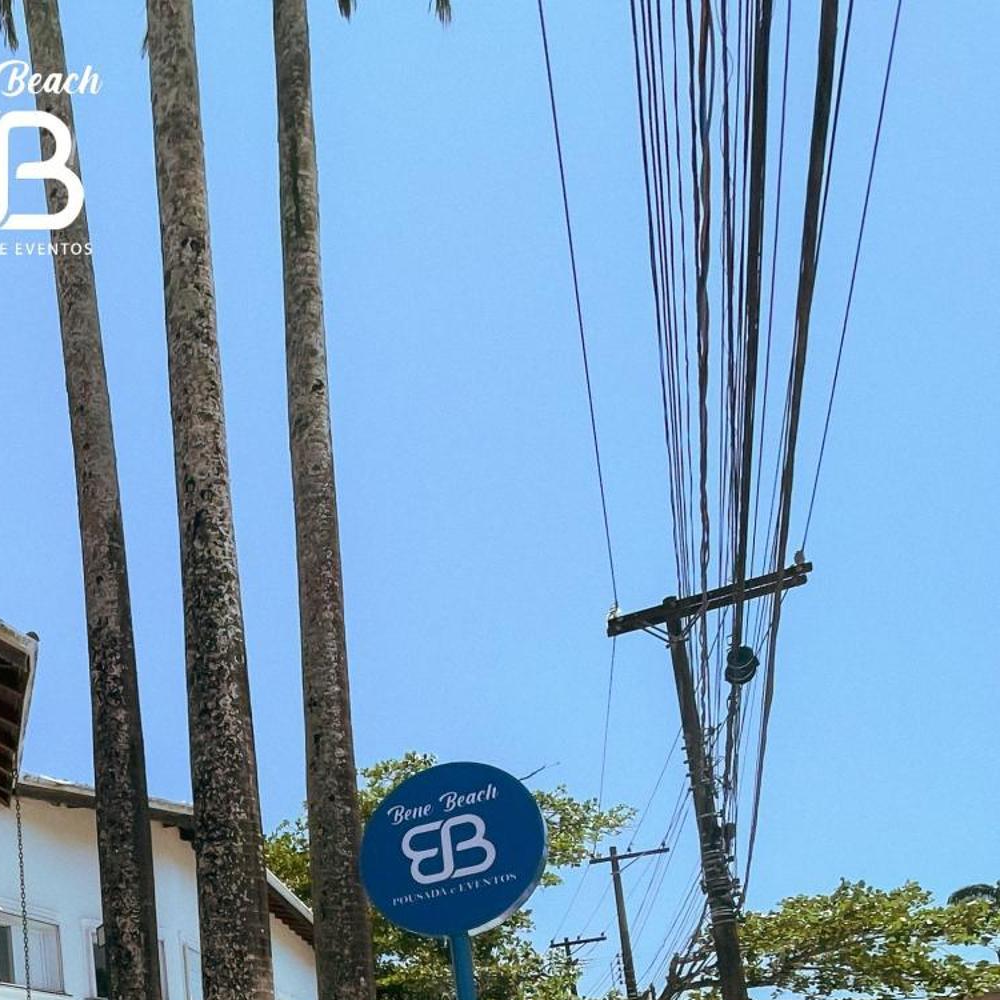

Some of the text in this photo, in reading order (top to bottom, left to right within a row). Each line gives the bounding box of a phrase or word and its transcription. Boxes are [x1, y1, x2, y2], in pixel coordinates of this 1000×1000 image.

[387, 783, 499, 826] Bene Beach
[392, 887, 448, 906] POUSADA
[458, 872, 517, 892] EVENTOS
